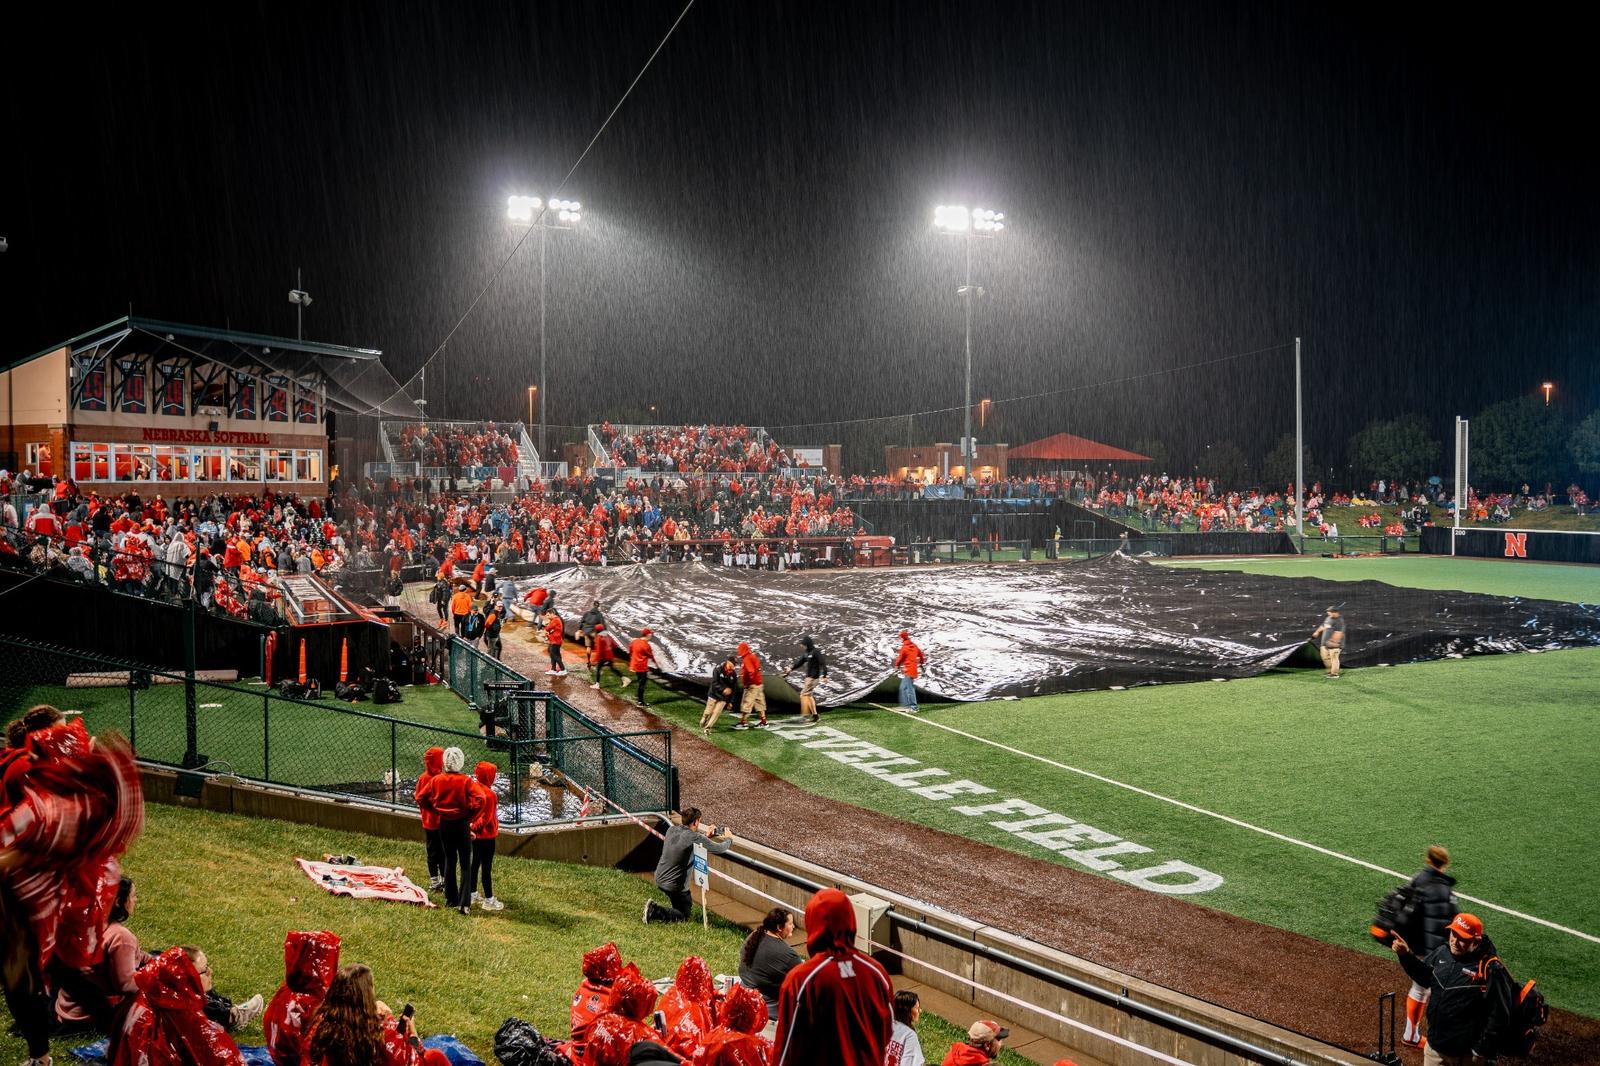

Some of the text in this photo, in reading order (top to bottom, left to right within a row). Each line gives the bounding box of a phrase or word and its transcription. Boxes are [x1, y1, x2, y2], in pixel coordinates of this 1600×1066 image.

[142, 427, 270, 445] NEBRASKA SOFTBALL
[1505, 532, 1527, 558] N
[951, 799, 1224, 894] FIELD
[837, 960, 857, 979] N
